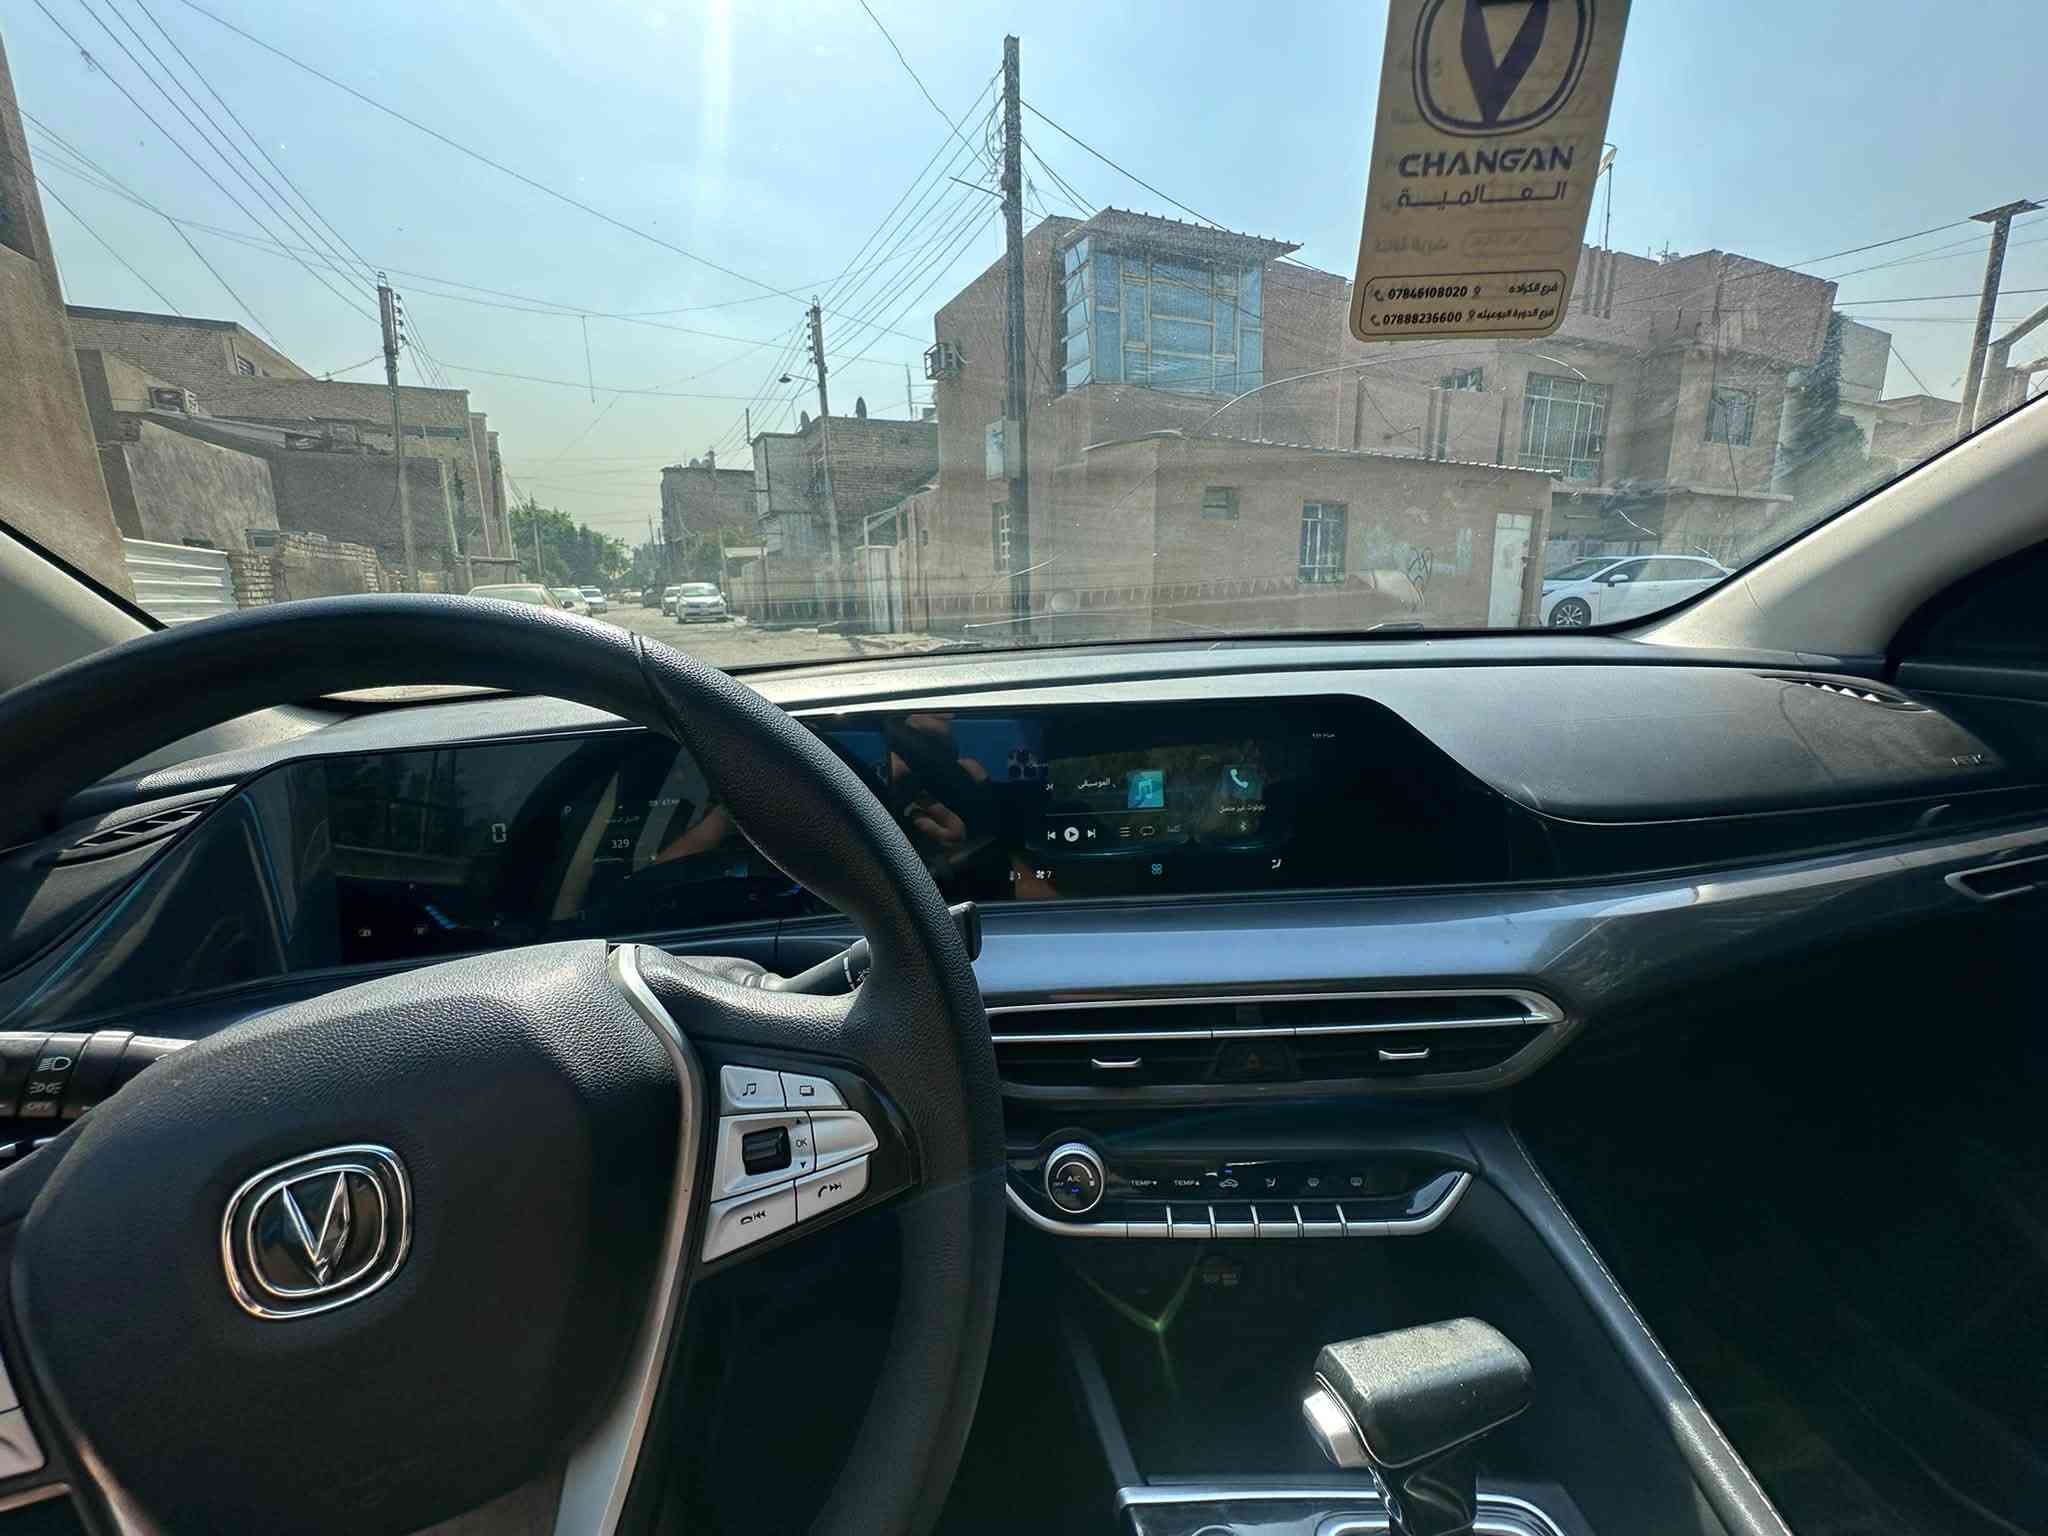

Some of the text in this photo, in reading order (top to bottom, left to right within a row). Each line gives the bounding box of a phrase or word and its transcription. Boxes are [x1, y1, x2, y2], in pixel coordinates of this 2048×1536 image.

[1398, 145, 1575, 178] CHANGAN
[563, 805, 573, 815] P
[491, 823, 507, 843] 0
[611, 838, 630, 849] 329
[795, 1138, 808, 1148] OK
[1067, 1175, 1081, 1183] A/C
